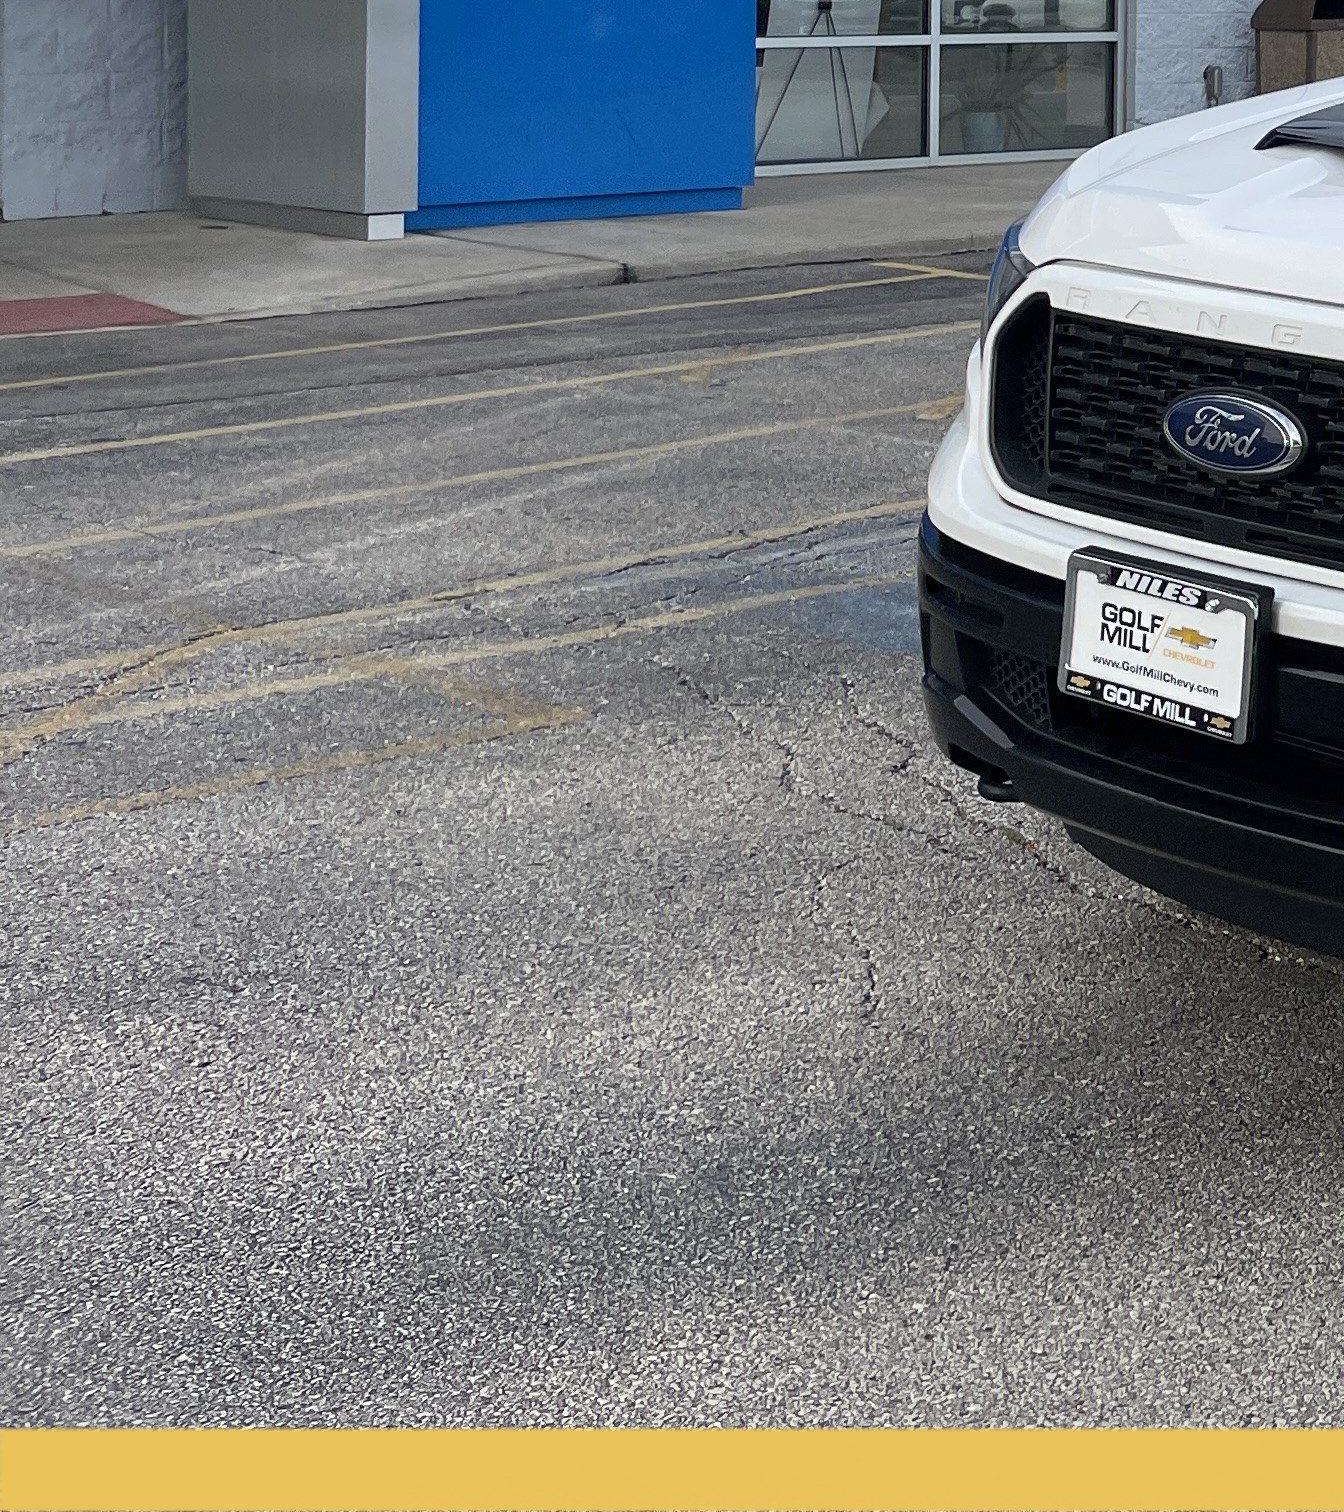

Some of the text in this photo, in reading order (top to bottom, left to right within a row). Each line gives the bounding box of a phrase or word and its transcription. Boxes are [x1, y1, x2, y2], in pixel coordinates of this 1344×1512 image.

[1185, 406, 1261, 459] Ford
[1116, 570, 1202, 606] NILES
[1101, 602, 1165, 634] GOLF
[1100, 622, 1150, 654] MILL
[1092, 653, 1219, 698] www.GolfMillChevy.com
[1163, 648, 1216, 669] CHEVROLET
